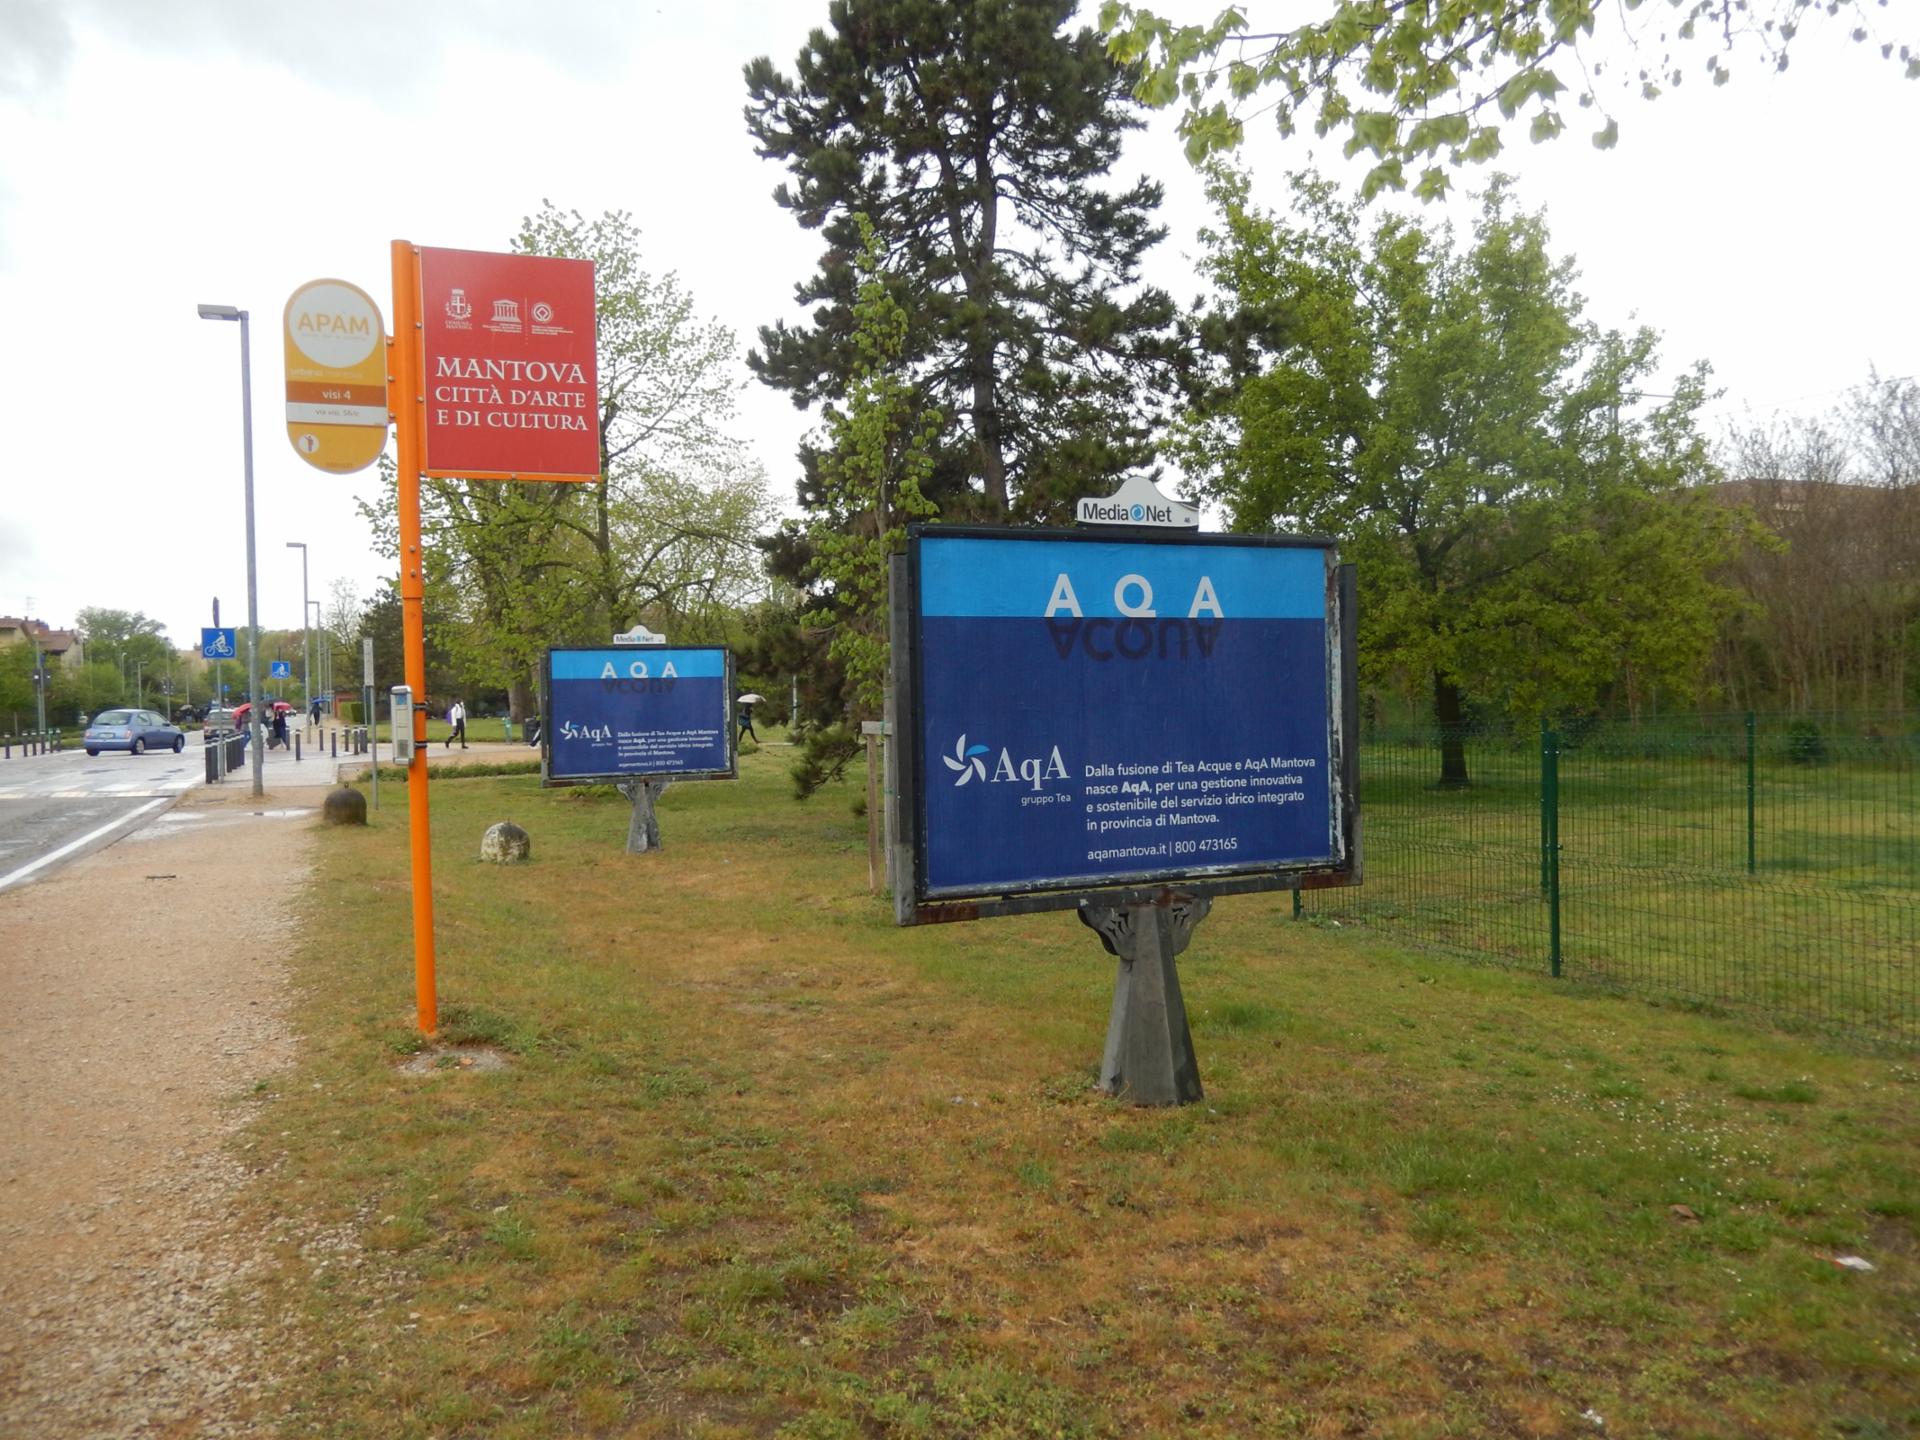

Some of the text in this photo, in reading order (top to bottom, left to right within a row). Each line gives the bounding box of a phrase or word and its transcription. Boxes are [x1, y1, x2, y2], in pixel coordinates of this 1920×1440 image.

[298, 312, 370, 336] APAM
[435, 356, 588, 384] MANTOVA
[322, 389, 351, 400] visi 4
[435, 384, 586, 408] CITTÀ D'ARTE
[436, 409, 589, 431] E DI CULTURA
[1083, 502, 1172, 522] Media Net
[579, 725, 612, 741] AqA
[990, 745, 1072, 791] AqA
[1085, 757, 1316, 777] Dalla fusione di Tea Acque e AqA Mantova
[1086, 773, 1303, 795] nasce AqA, per una gestione innovativa
[1021, 793, 1072, 807] gruppo Tea
[1086, 791, 1305, 813] e sostenibile del servizio idrico integrato
[1087, 813, 1220, 833] in provincia di Mantova.
[1088, 837, 1238, 862] aqamantova.it 800 473165
